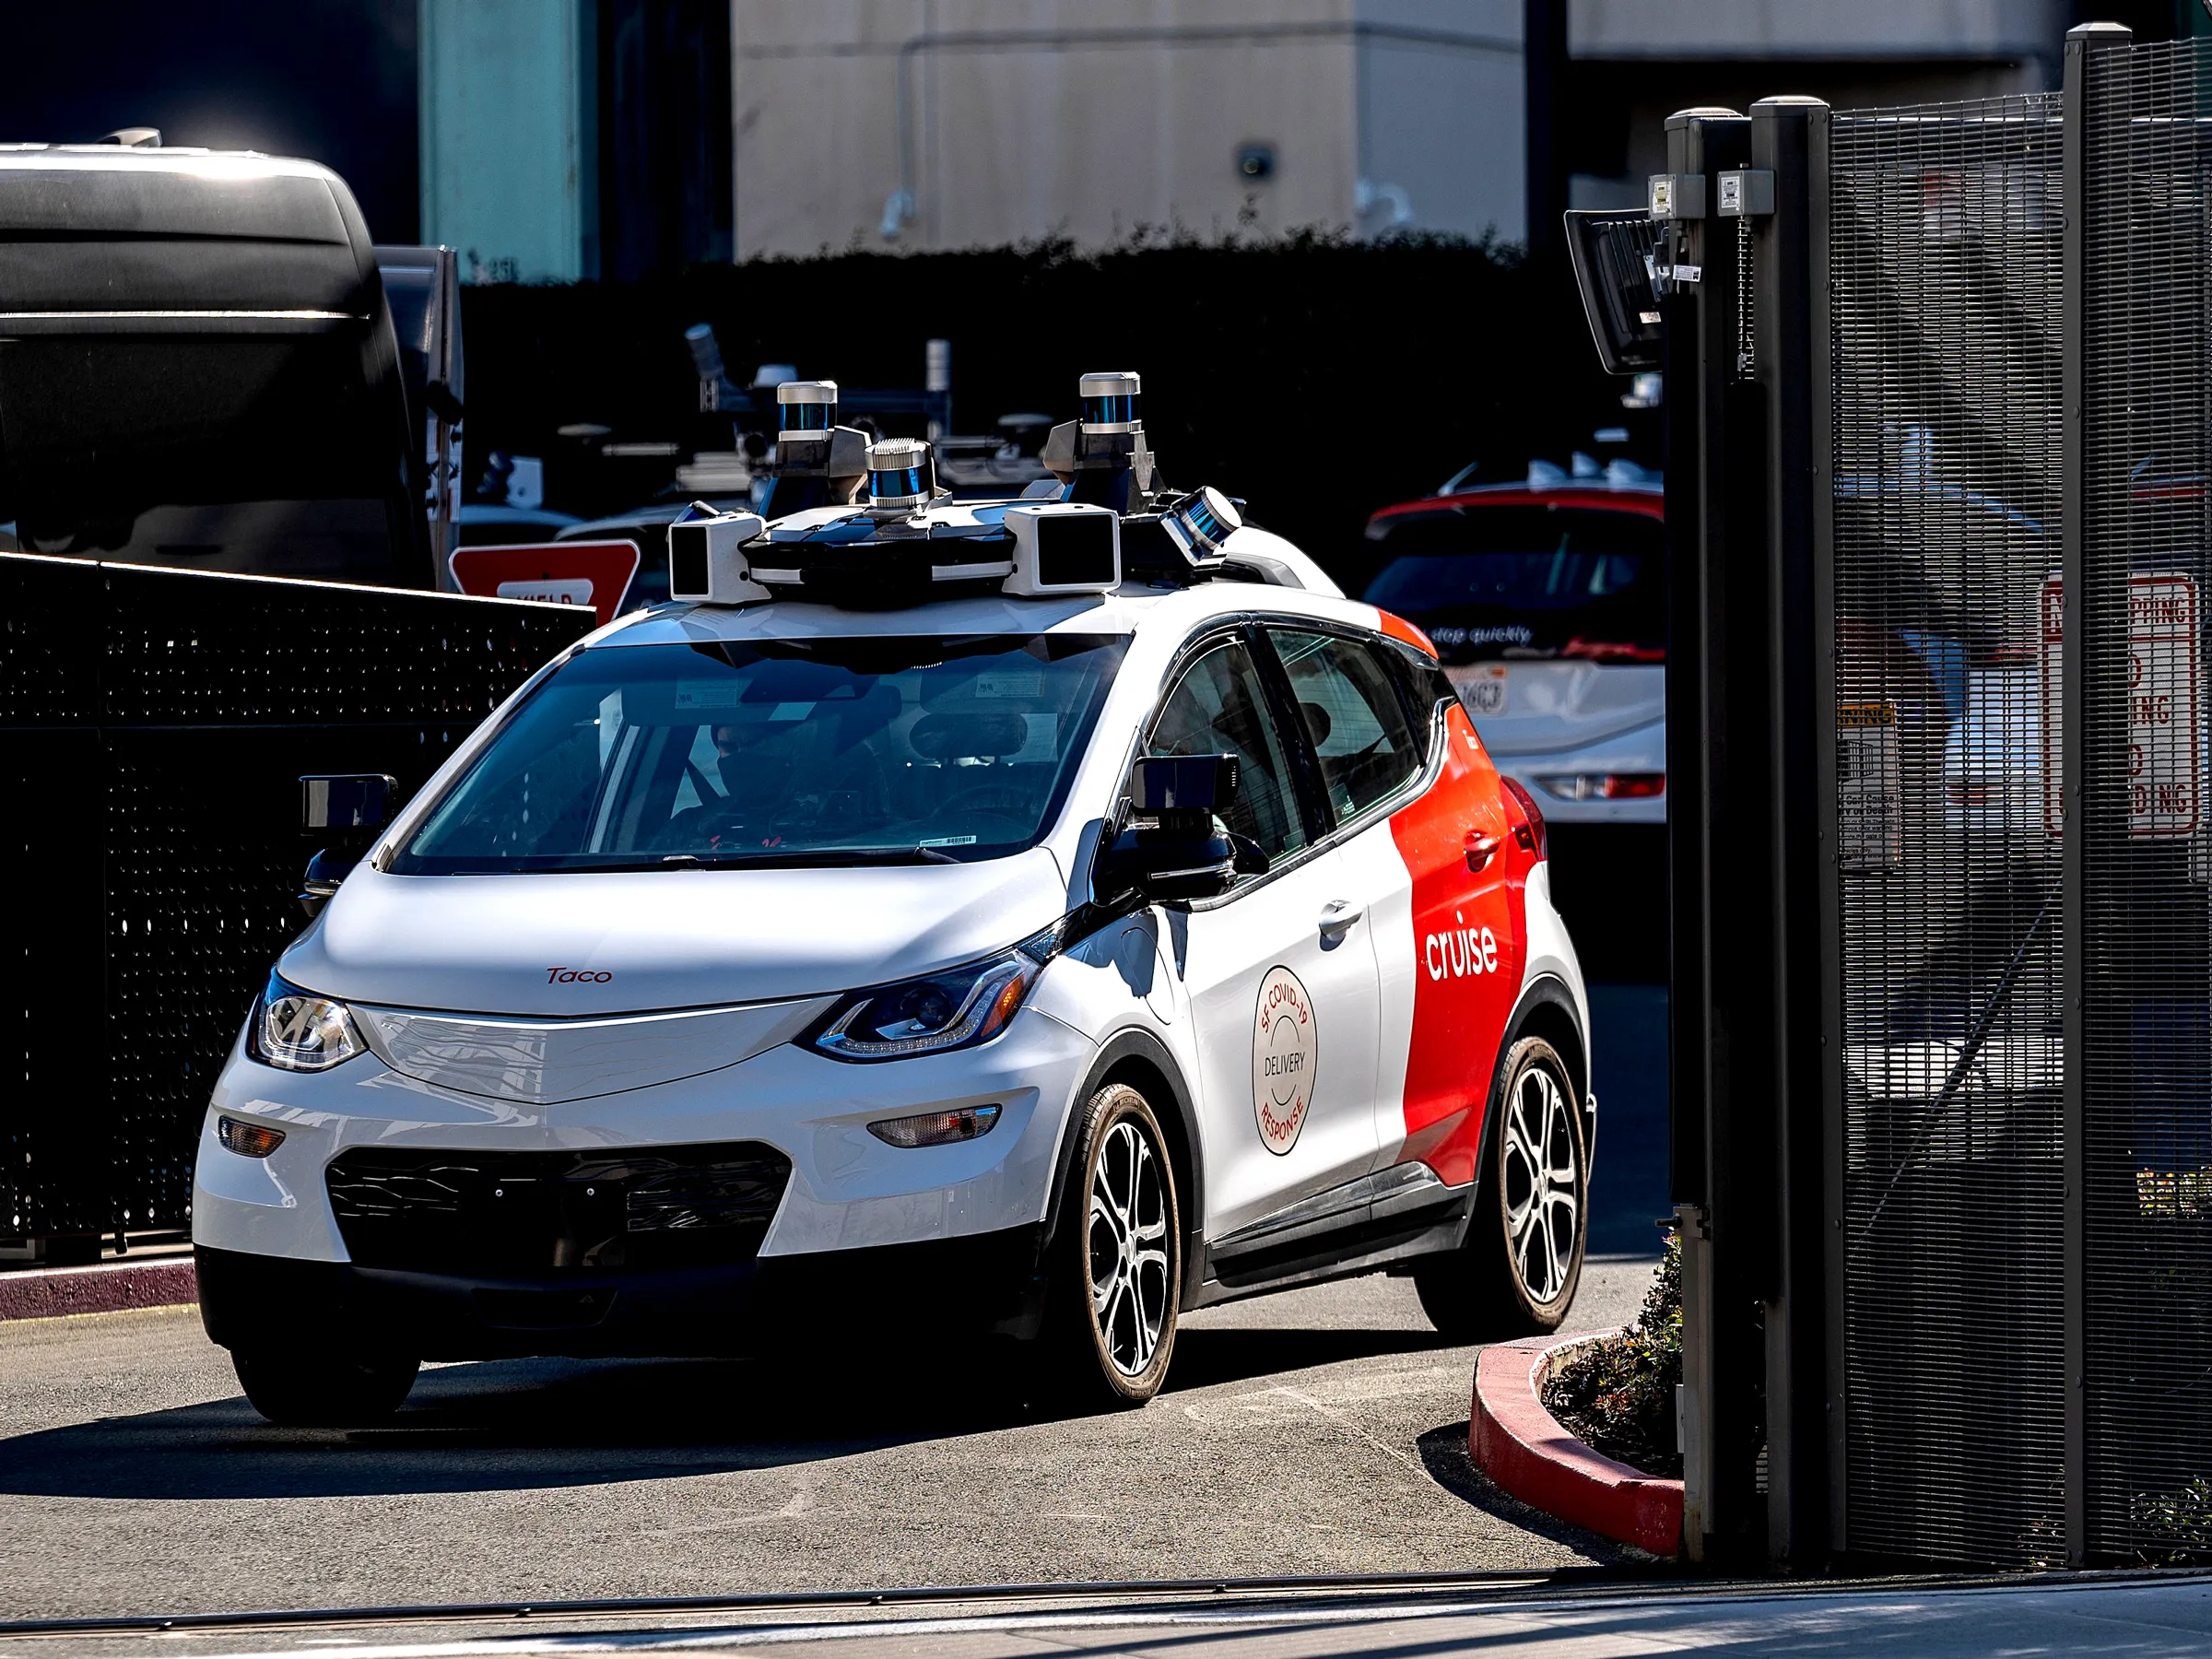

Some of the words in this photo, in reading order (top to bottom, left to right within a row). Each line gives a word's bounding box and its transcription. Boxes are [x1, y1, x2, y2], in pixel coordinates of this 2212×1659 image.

[1469, 624, 1534, 646] quickly
[1426, 911, 1498, 982] cruise
[547, 966, 612, 984] Taco
[1261, 1004, 1271, 1033] SF
[1268, 983, 1308, 1025] COVID-19
[1265, 1052, 1306, 1077] DELIVERY
[1261, 1095, 1304, 1141] RESPONSE
